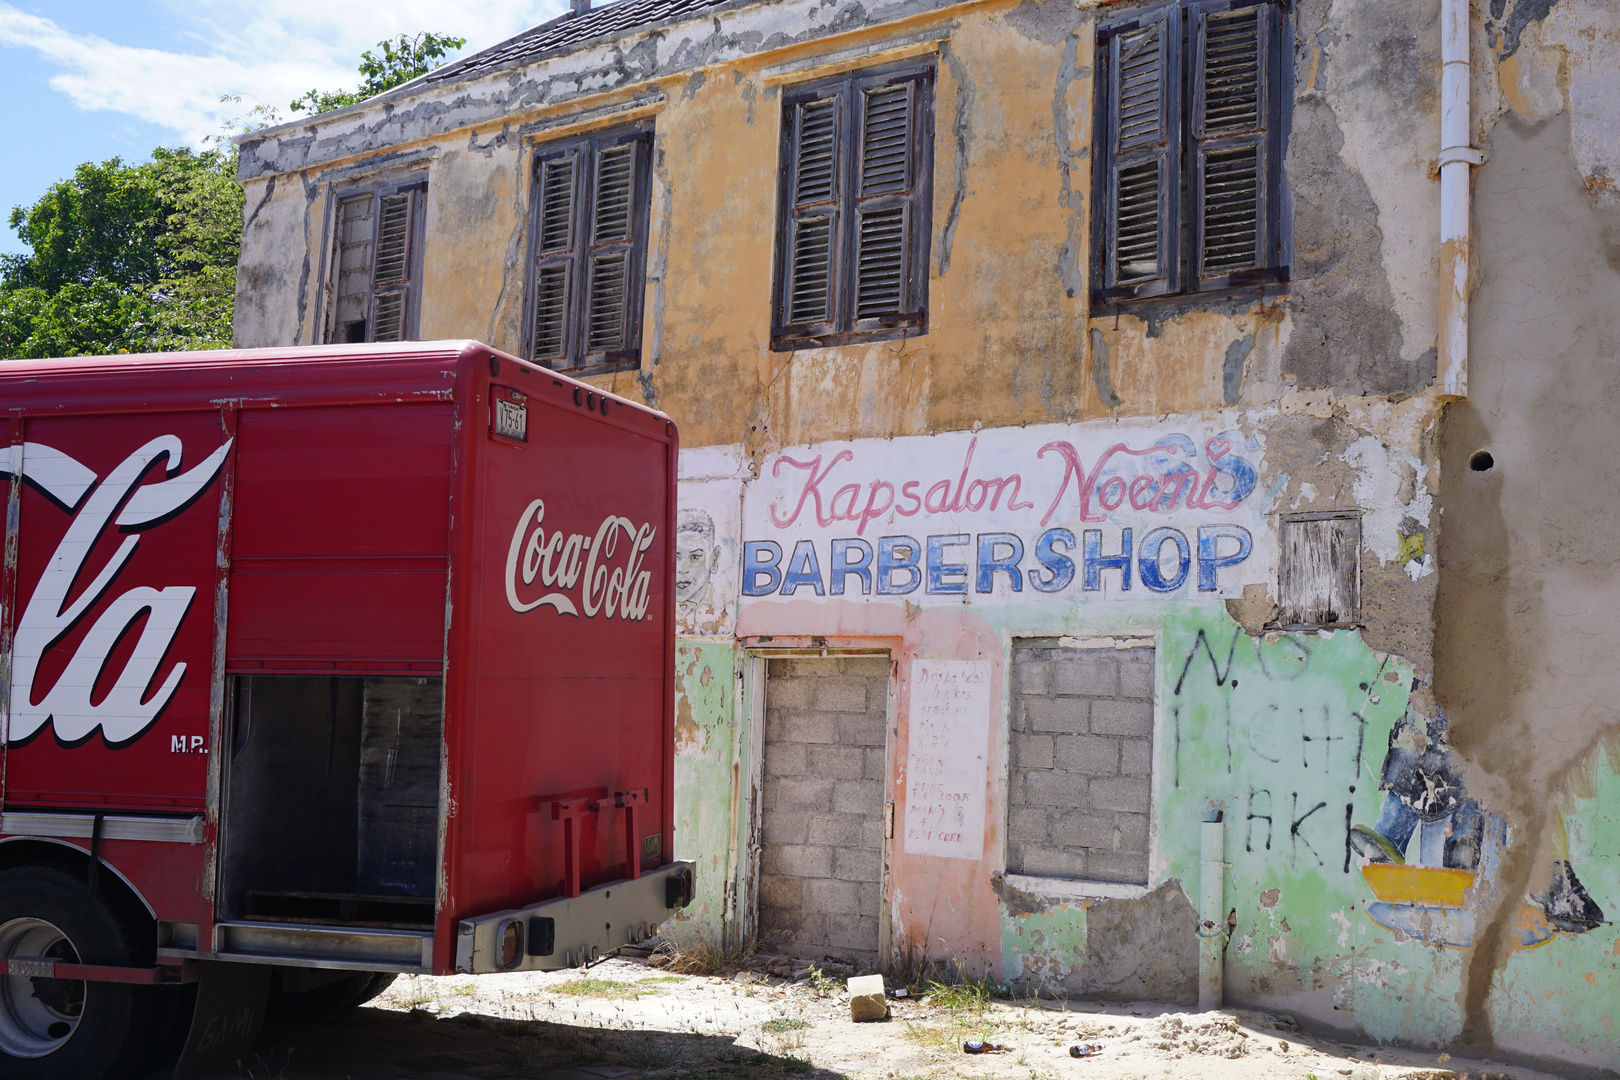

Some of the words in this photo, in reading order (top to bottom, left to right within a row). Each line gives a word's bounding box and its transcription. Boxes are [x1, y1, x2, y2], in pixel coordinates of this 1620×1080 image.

[769, 437, 1034, 535] Kapsalon
[1037, 437, 1243, 526] Noemi
[505, 499, 657, 621] Coca-Cola
[742, 523, 1254, 597] BARBERSHOP
[939, 792, 971, 802] LOOK
[938, 831, 962, 843] CURE
